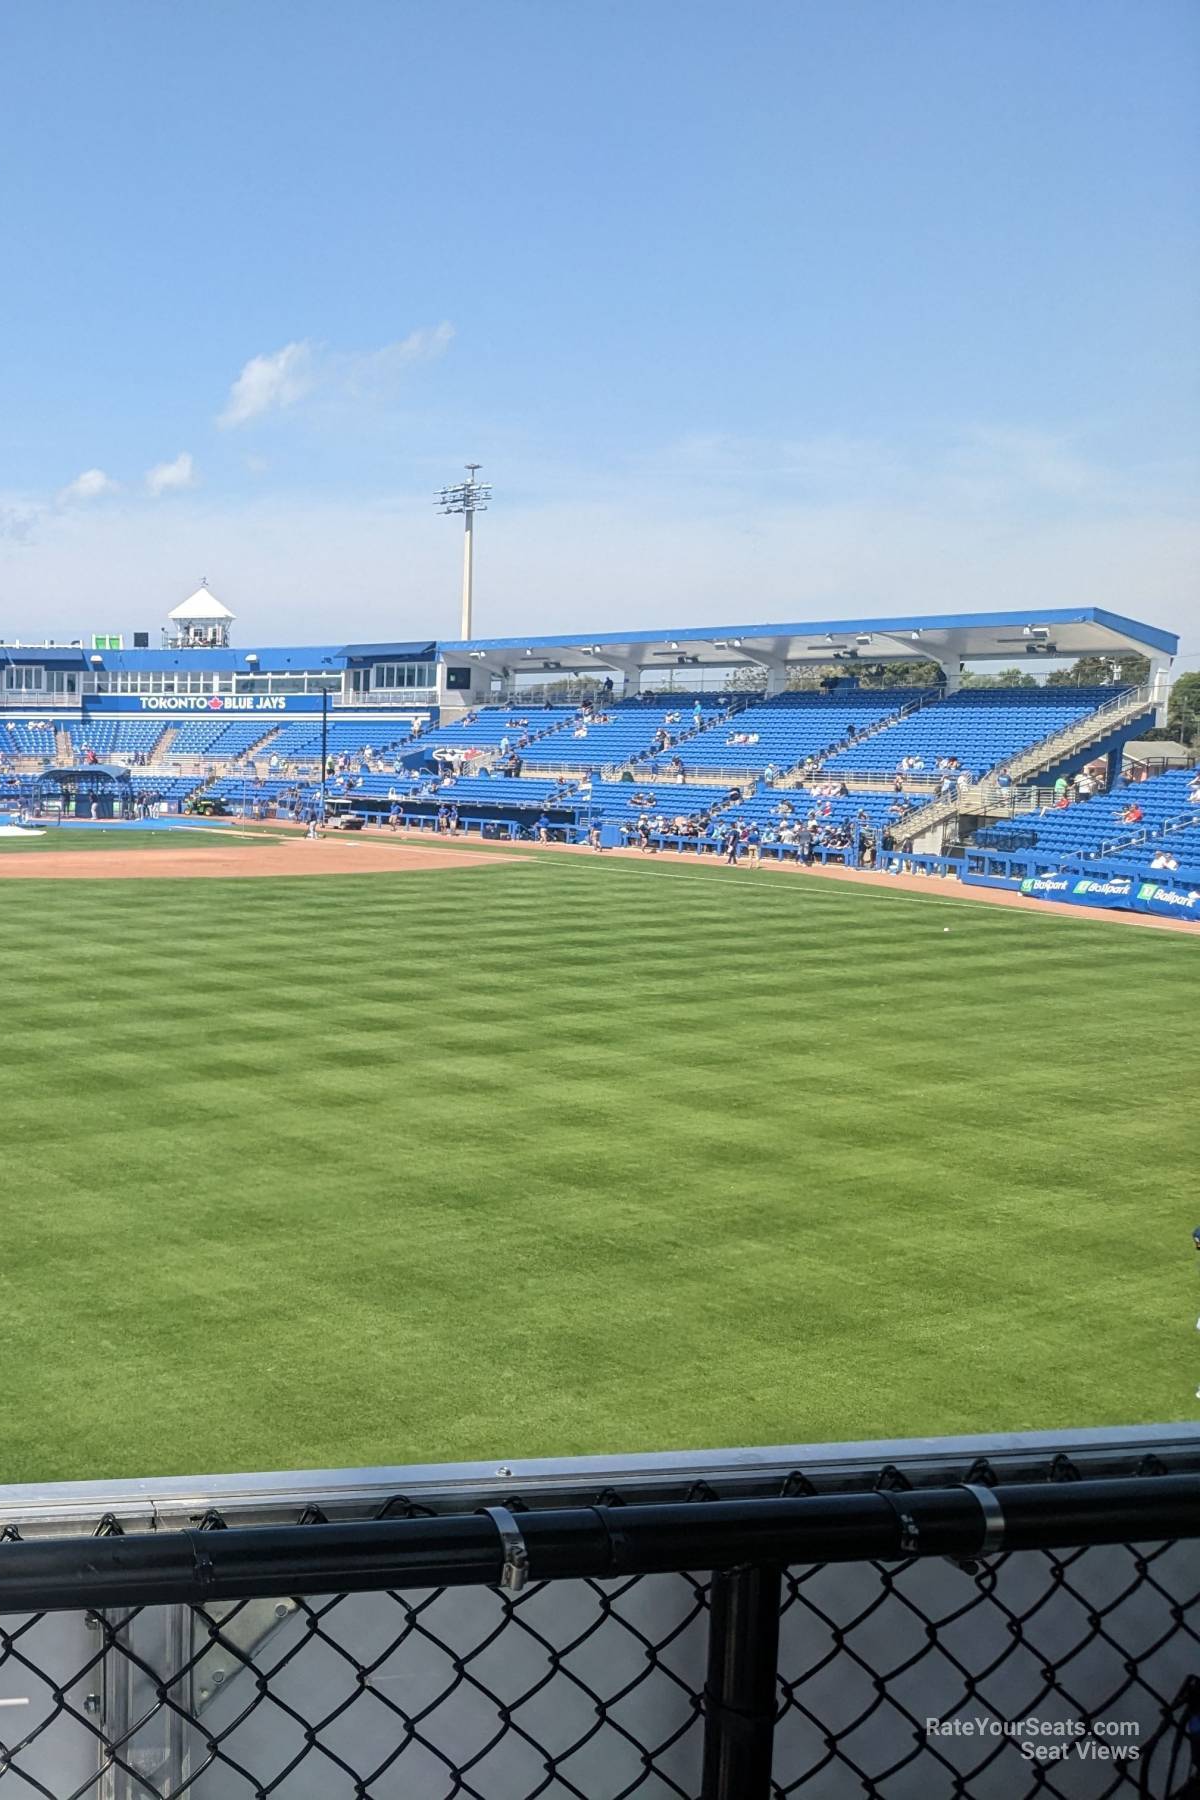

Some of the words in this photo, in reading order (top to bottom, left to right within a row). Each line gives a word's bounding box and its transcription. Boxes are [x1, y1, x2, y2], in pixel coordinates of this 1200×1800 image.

[139, 697, 208, 710] TORONTO
[224, 697, 253, 710] BLUE
[256, 697, 286, 710] JAYS
[1088, 882, 1131, 895] Ballpark
[1153, 888, 1196, 907] Ballpark
